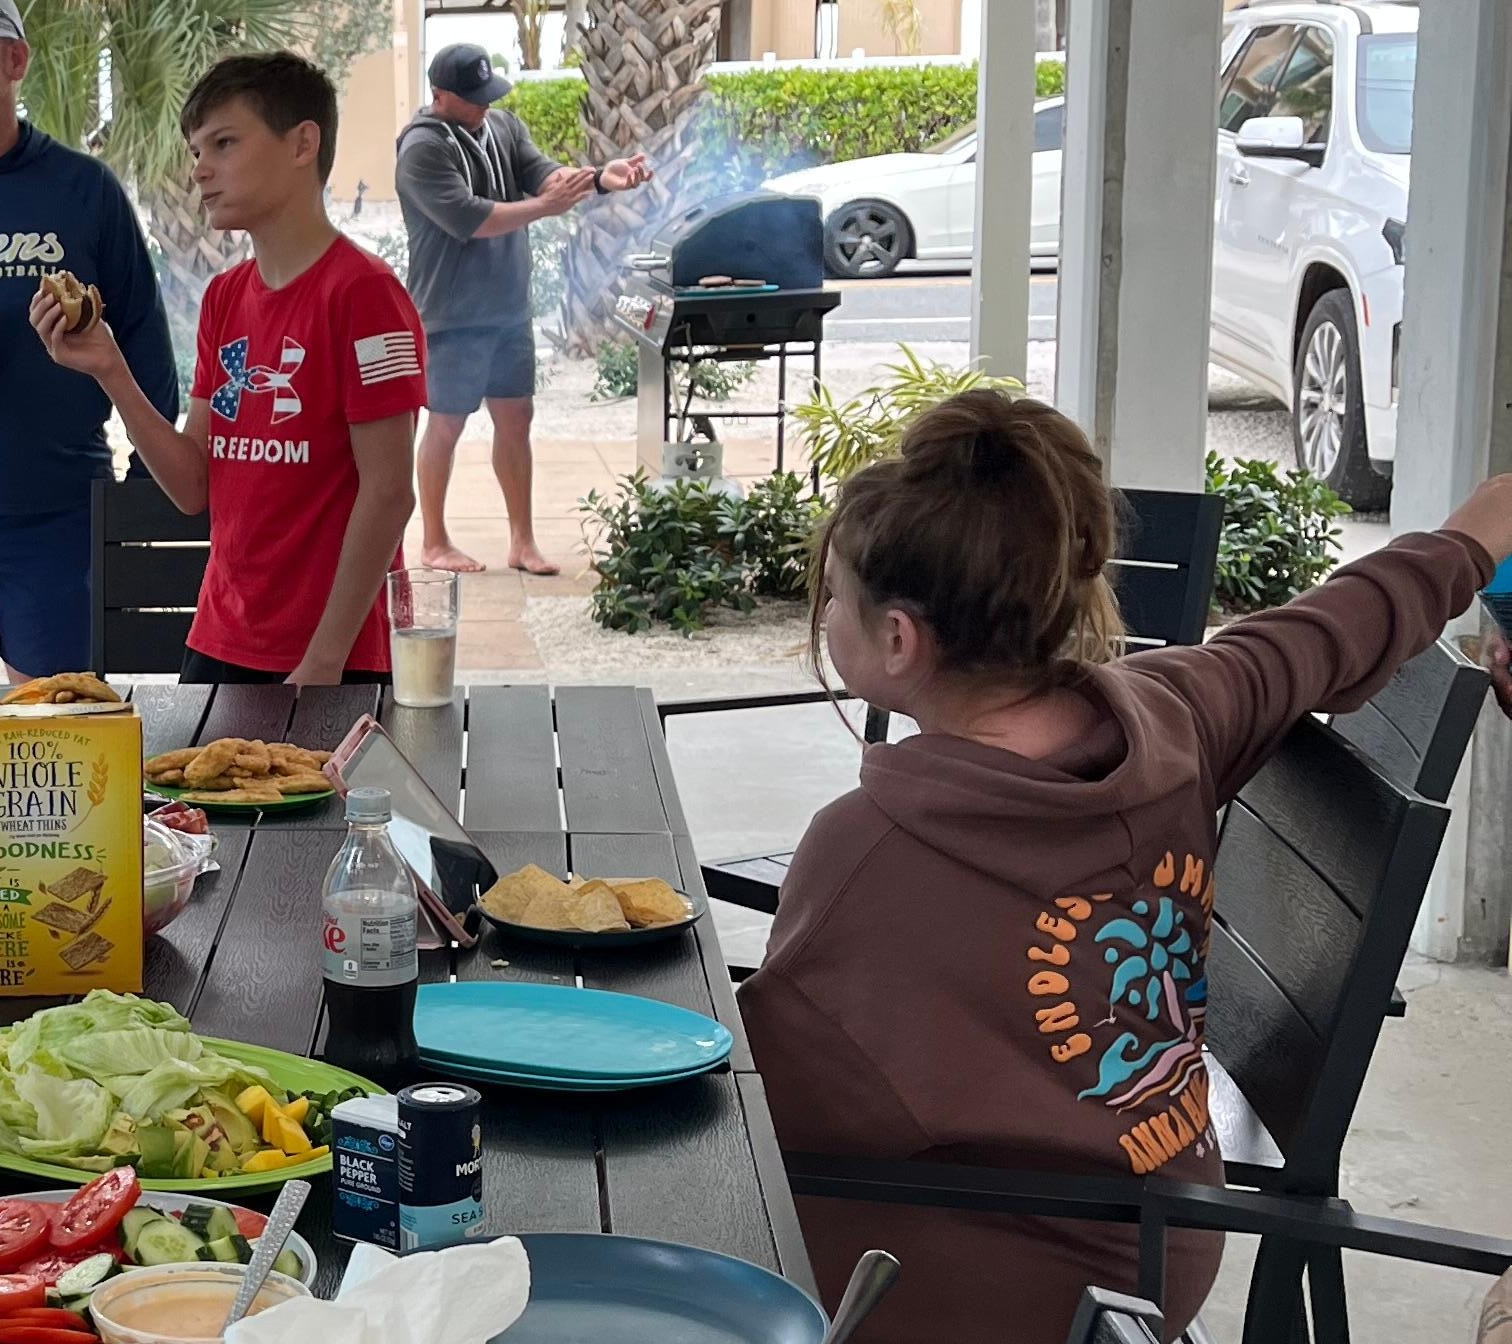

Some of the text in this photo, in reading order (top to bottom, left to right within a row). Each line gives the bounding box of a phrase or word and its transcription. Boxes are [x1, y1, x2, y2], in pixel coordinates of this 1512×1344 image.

[8, 741, 63, 760] 100%
[0, 818, 67, 832] WHEAT THINS
[9, 878, 20, 887] IS
[7, 960, 16, 968] IS
[339, 1153, 375, 1173] BLACK
[455, 1157, 483, 1177] MOR
[340, 1165, 377, 1185] PEPPER
[340, 1177, 381, 1194] PURE GROUND
[451, 1211, 477, 1225] SEA
